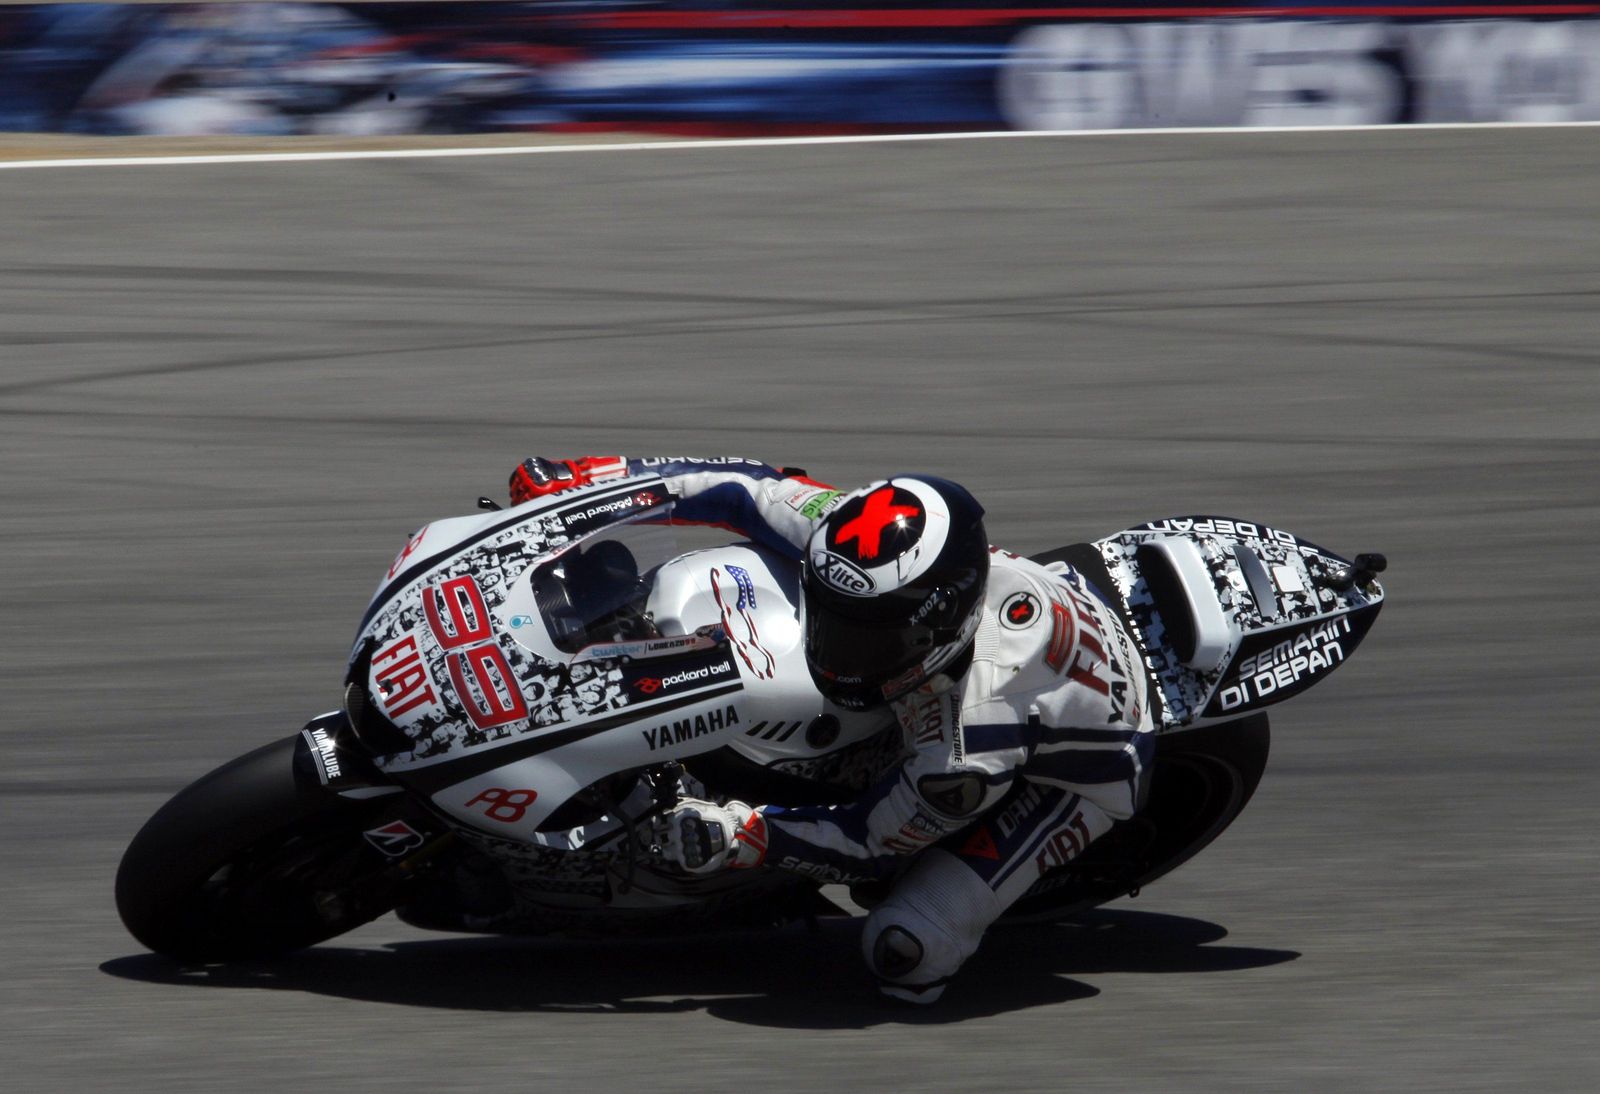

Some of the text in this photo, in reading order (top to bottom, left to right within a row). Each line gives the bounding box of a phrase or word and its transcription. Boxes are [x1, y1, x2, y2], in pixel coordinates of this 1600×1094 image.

[565, 509, 589, 525] bell
[813, 554, 867, 592] X-lite
[422, 573, 529, 731] 99
[592, 643, 642, 656] twitter
[1238, 615, 1351, 682] SEMAKIN
[371, 634, 437, 719] FIAT
[662, 667, 708, 688] packard
[710, 661, 731, 674] bell
[1220, 642, 1344, 711] DI DEPAN
[642, 704, 739, 751] YAMAHA
[310, 727, 341, 779] YAMALUBE
